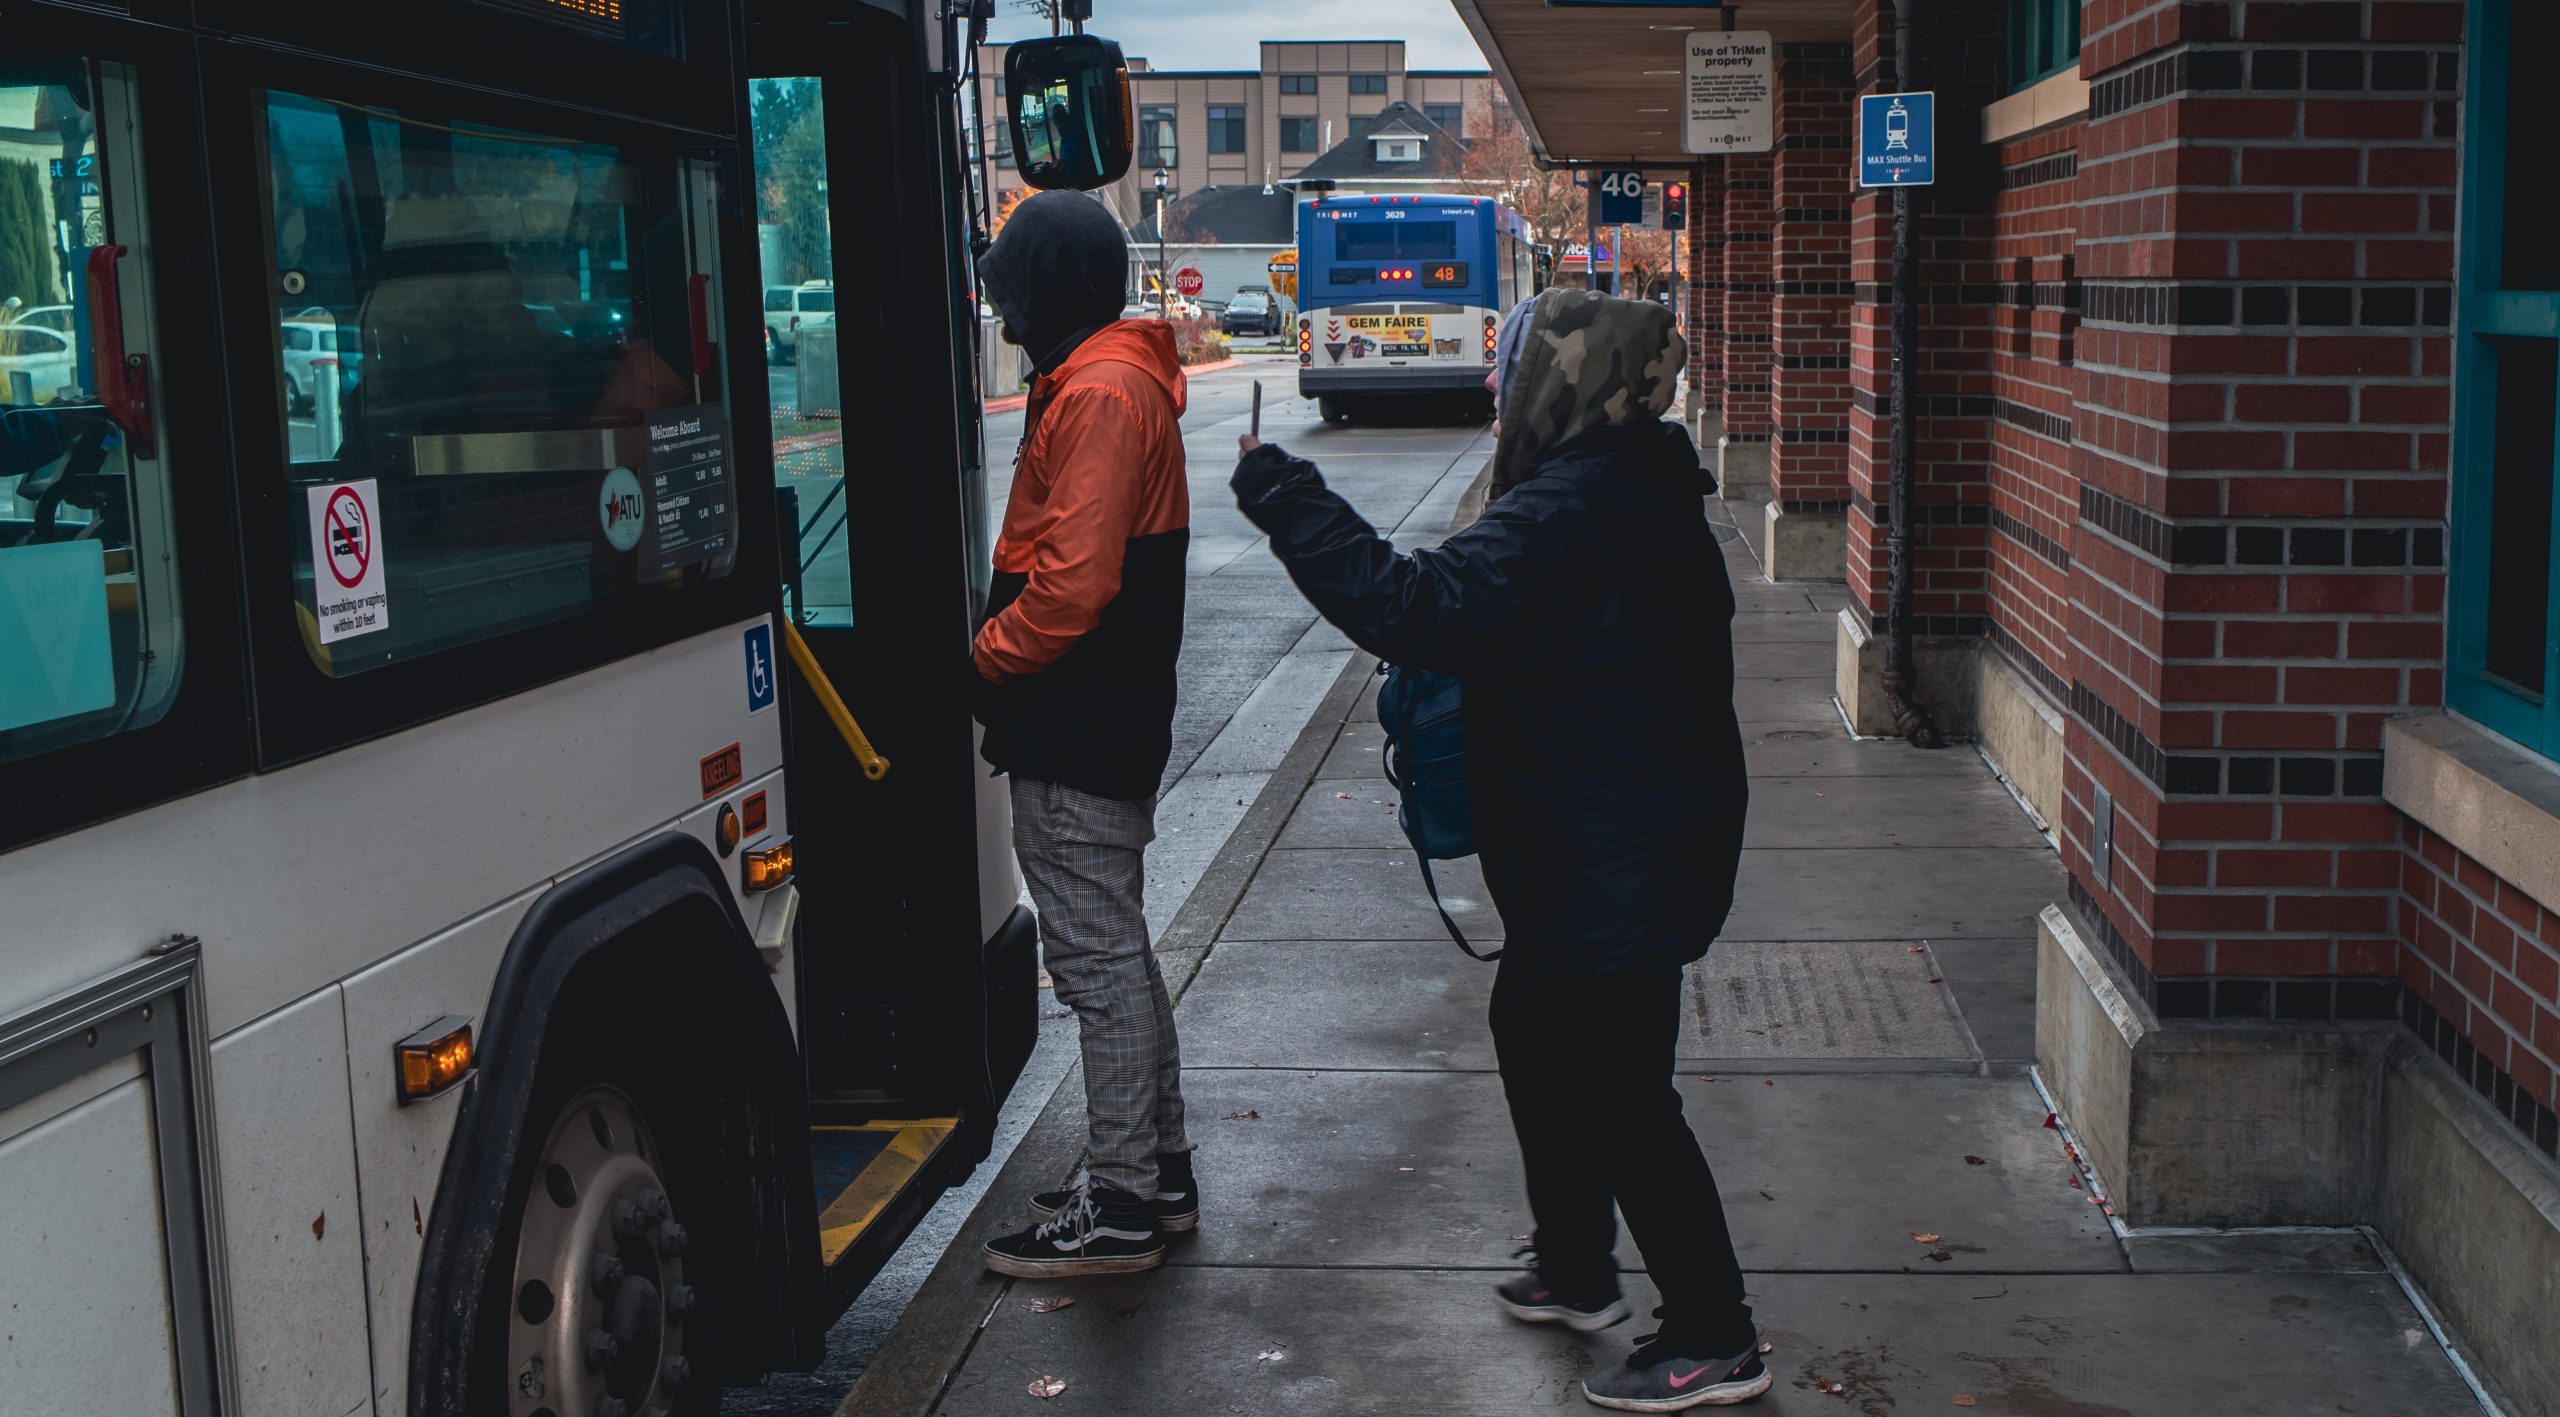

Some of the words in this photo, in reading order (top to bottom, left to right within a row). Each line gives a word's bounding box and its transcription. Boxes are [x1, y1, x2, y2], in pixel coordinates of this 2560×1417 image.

[1692, 46, 1713, 56] Use
[1717, 46, 1728, 56] of
[1731, 45, 1766, 55] TriMet
[1705, 56, 1753, 68] property
[1867, 156, 1885, 164] MAX
[1886, 155, 1912, 164] Shuttle
[1914, 154, 1927, 163] Bus
[1602, 172, 1642, 198] 46
[1385, 210, 1405, 219] 3629
[1442, 208, 1475, 216] trimet.org
[1434, 266, 1454, 281] 48
[1177, 277, 1202, 288] STOP
[1349, 318, 1380, 328] GEM
[1385, 317, 1425, 328] FAIRE
[650, 424, 678, 440] Welcome
[680, 418, 701, 435] Aboard
[655, 475, 667, 487] Adult
[620, 494, 641, 520] ATU
[662, 511, 675, 524] Youth
[320, 604, 329, 618] No
[330, 598, 357, 614] smoking
[358, 598, 364, 609] or
[364, 592, 386, 610] vaping
[333, 617, 354, 634] within
[355, 616, 363, 628] 10
[363, 612, 376, 627] feet
[703, 751, 739, 792] KNEELING
[745, 800, 765, 830] RAMP
